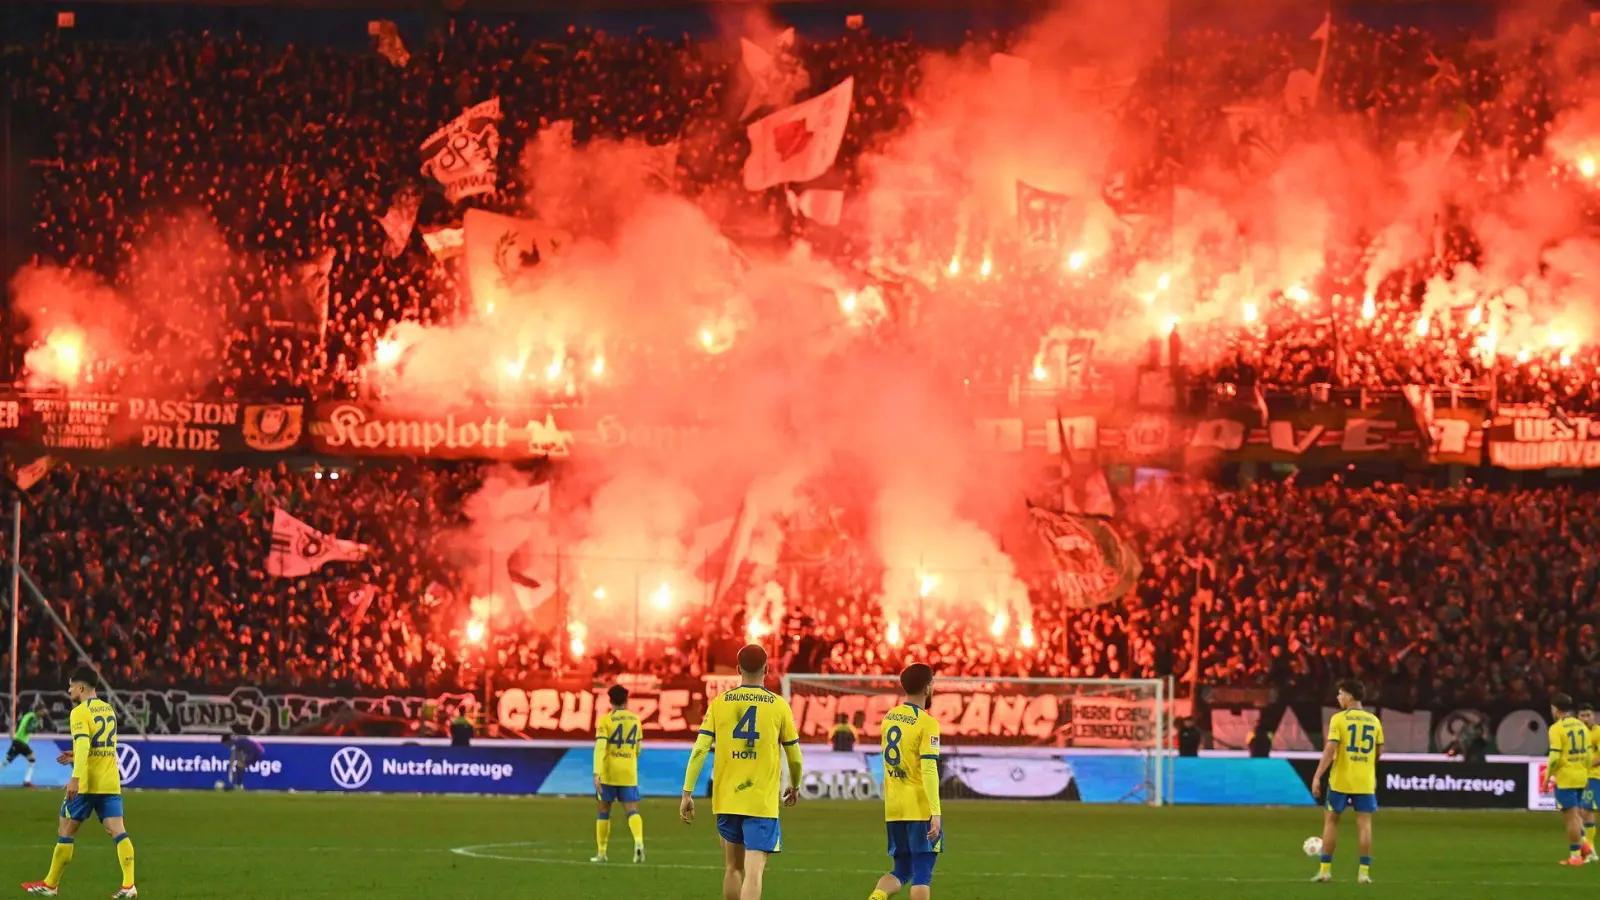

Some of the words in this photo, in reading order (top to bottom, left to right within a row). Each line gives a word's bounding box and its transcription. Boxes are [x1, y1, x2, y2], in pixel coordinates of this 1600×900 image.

[128, 398, 238, 425] PASSION
[141, 426, 221, 450] PRIDE
[325, 405, 509, 453] Komplott
[724, 693, 775, 704] BRAUNSCHWEIG
[91, 715, 116, 748] 22
[608, 723, 638, 750] 44
[732, 705, 760, 748] 4
[1346, 723, 1375, 755] 15
[732, 751, 757, 760] HOTI
[884, 725, 902, 767] 8
[1566, 729, 1587, 755] 11
[382, 758, 513, 780] Nutzfahrzeuge
[1386, 772, 1516, 796] Nutzfahrzeuge
